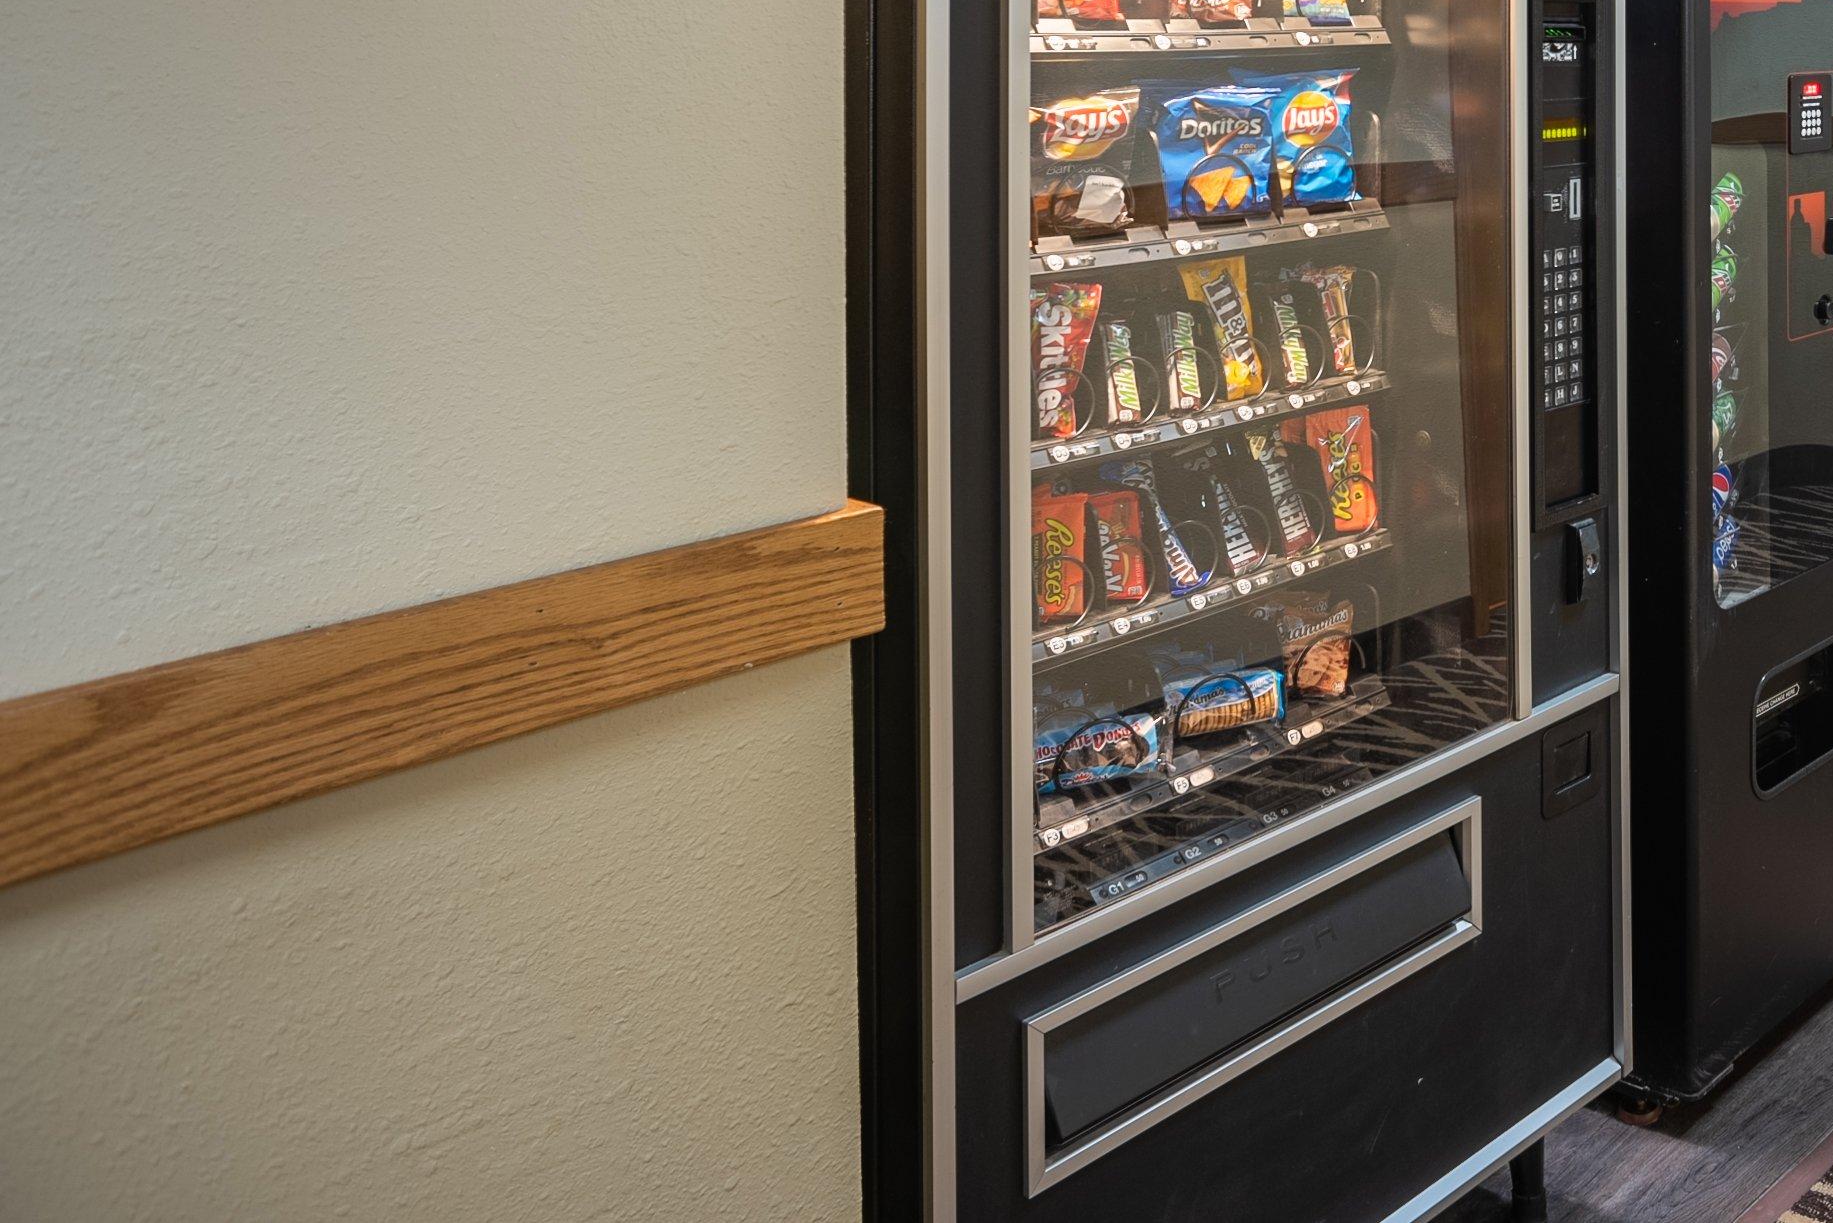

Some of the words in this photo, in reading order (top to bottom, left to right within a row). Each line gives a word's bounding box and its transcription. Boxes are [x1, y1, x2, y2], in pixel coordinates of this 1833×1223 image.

[1179, 117, 1262, 140] Doritos
[1288, 105, 1336, 135] Lay's
[1037, 301, 1073, 428] Skittles
[1044, 518, 1074, 606] Reese's
[1035, 734, 1092, 759] HOCOATE
[1322, 784, 1336, 798] G4
[1262, 810, 1279, 824] G3
[1184, 846, 1202, 860] G2
[1108, 881, 1125, 895] G1
